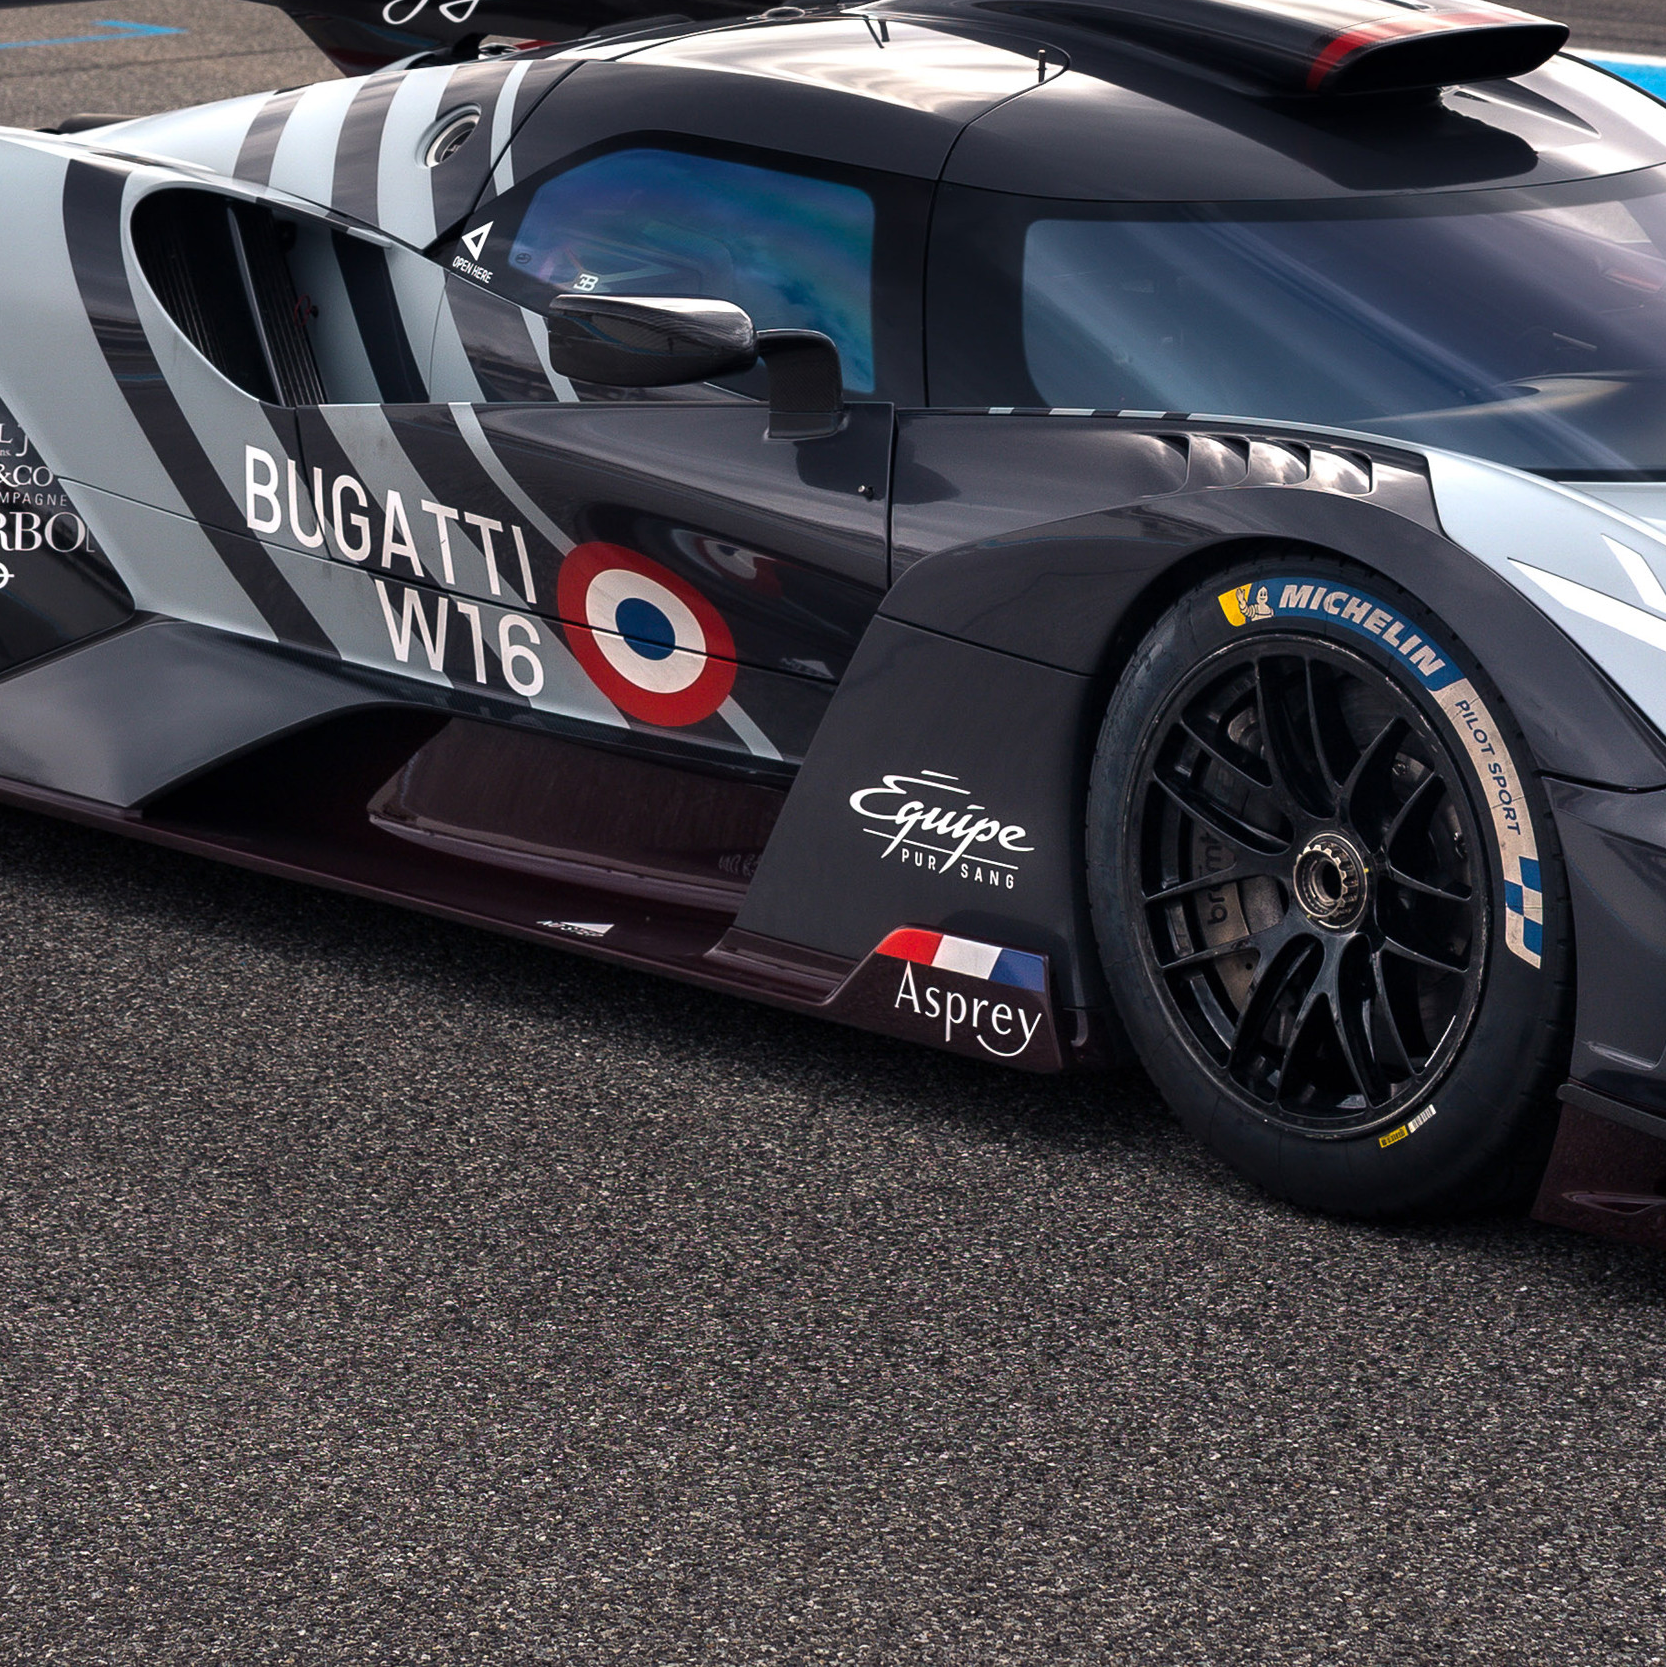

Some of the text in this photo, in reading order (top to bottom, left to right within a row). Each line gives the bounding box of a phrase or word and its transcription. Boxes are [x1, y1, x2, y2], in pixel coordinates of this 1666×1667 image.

[451, 255, 494, 284] OPEN HERE
[245, 444, 537, 604] BUGATTI
[374, 579, 545, 697] W16
[1278, 584, 1521, 836] MICHELIN PILOT SPORT
[901, 848, 1015, 890] PUR SANG
[894, 961, 1043, 1057] Asprey
